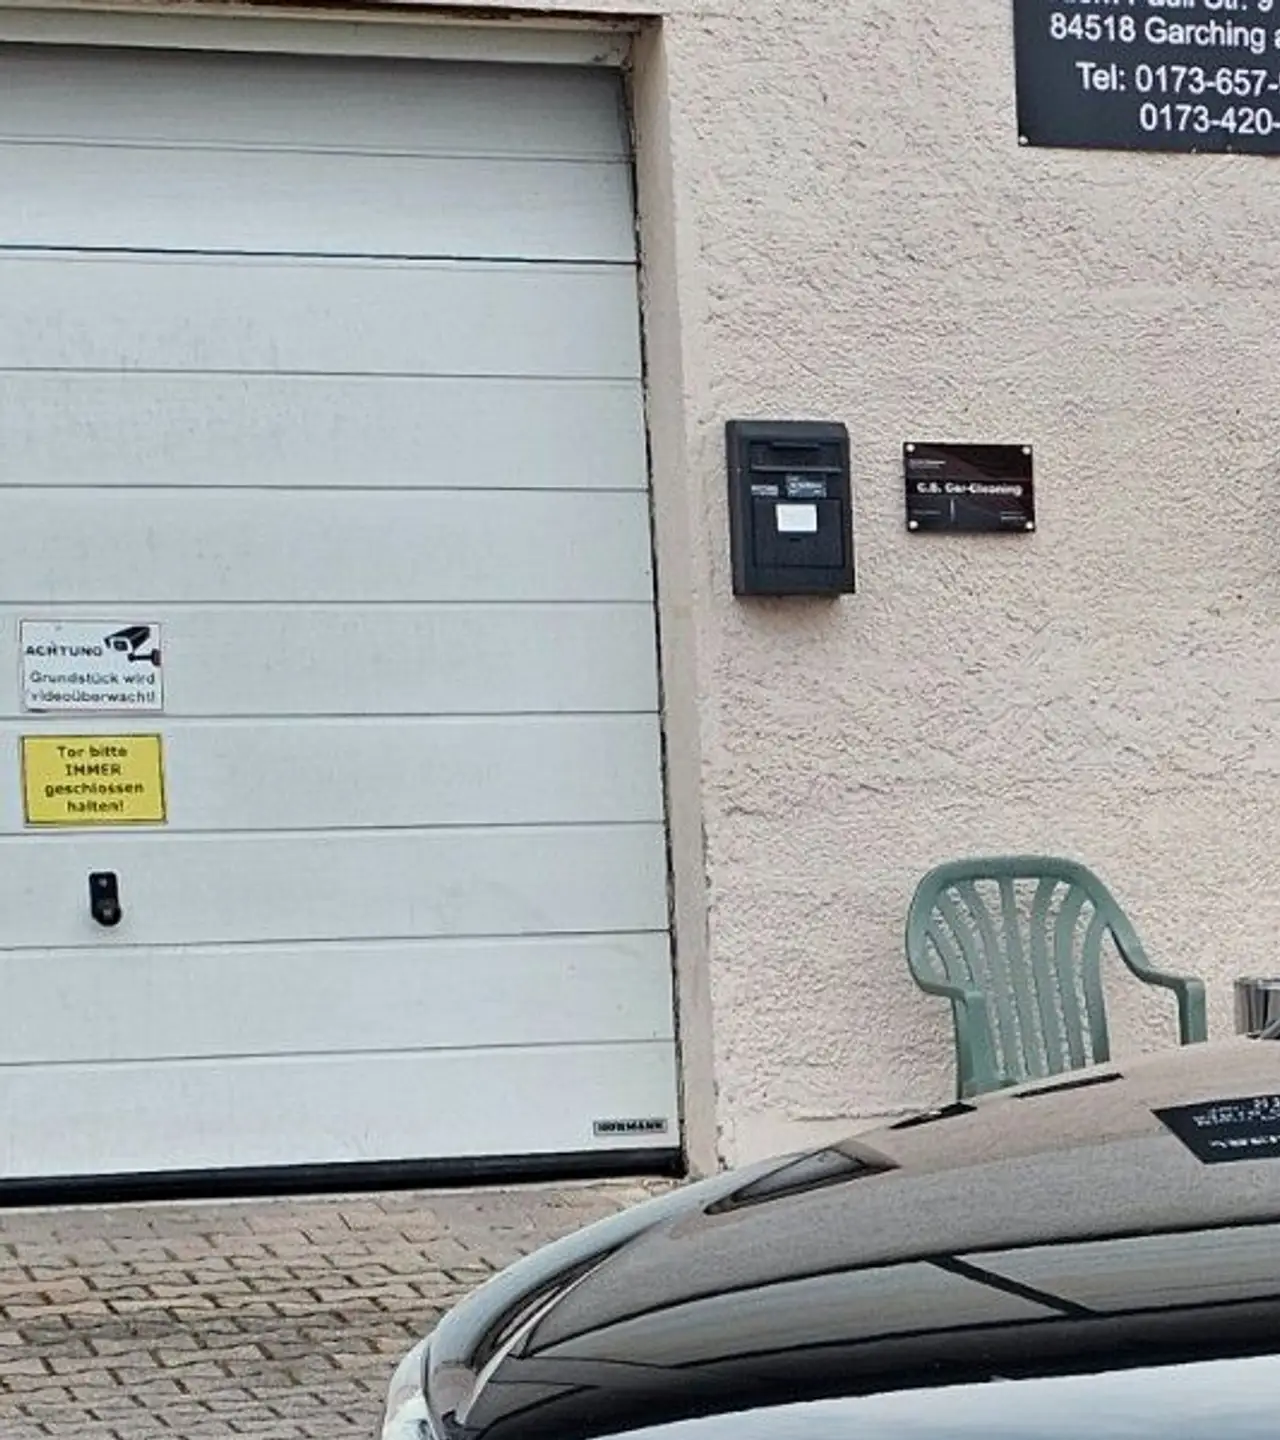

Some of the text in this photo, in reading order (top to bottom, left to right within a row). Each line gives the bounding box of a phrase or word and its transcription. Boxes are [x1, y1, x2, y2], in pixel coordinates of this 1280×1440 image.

[1049, 13, 1137, 43] 84518
[1145, 18, 1266, 54] Garching
[1076, 62, 1126, 92] Tel:
[26, 645, 103, 657] ACHTUNG
[30, 670, 155, 685] Grundstück wird
[57, 744, 128, 758] Tor bitte
[65, 763, 122, 776] IMMER
[45, 783, 144, 798] geschlossen
[67, 800, 124, 813] halten!
